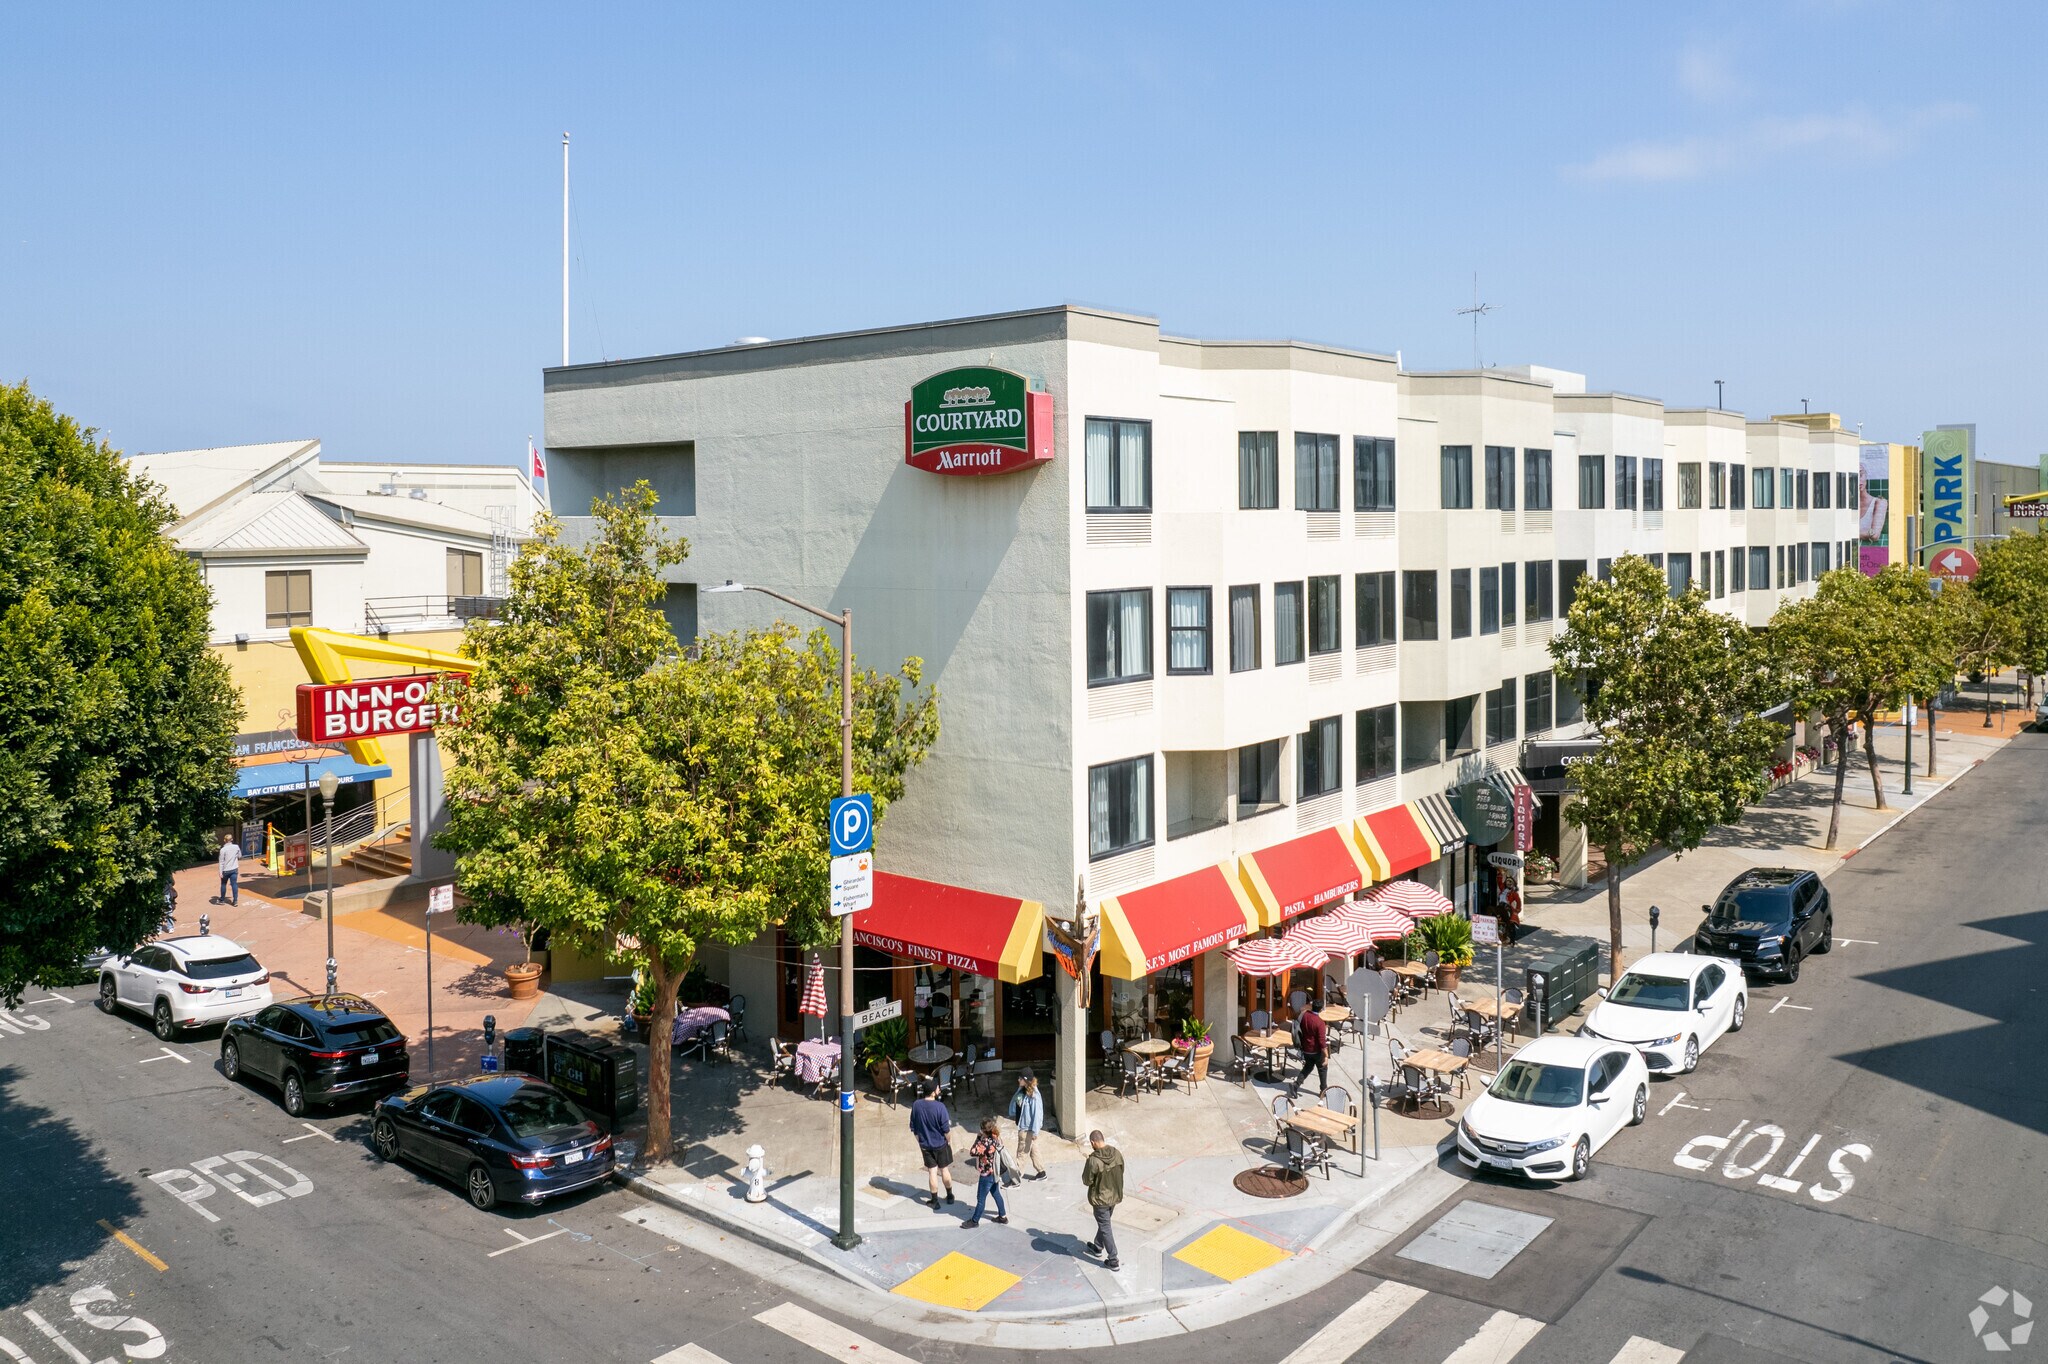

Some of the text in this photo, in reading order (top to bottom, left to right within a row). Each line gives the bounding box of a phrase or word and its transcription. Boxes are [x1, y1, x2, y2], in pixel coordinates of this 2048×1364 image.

[916, 408, 1022, 433] COURTYARD
[936, 448, 1002, 470] Marriott
[1934, 454, 1962, 544] PARK
[325, 677, 462, 713] IN-N-O
[325, 703, 459, 737] BURGER
[231, 743, 250, 756] AN
[254, 739, 309, 753] FRANCISCO
[247, 788, 261, 797] BAY
[262, 785, 279, 794] CITY
[279, 783, 294, 792] BIKE
[337, 776, 354, 784] OURS
[1517, 788, 1526, 849] LIQUORS
[1491, 855, 1520, 867] LIQUOR!
[1284, 881, 1359, 916] PASTA HAMBURGERS
[853, 931, 979, 971] ANCISCO'S FINEST PIZZA
[1168, 944, 1190, 962] MOST
[1193, 931, 1224, 951] FAMOUS
[1226, 922, 1248, 941] PIZZA
[861, 1006, 895, 1024] BEACH
[1673, 1119, 1873, 1202] STOP
[148, 1151, 314, 1223] PED
